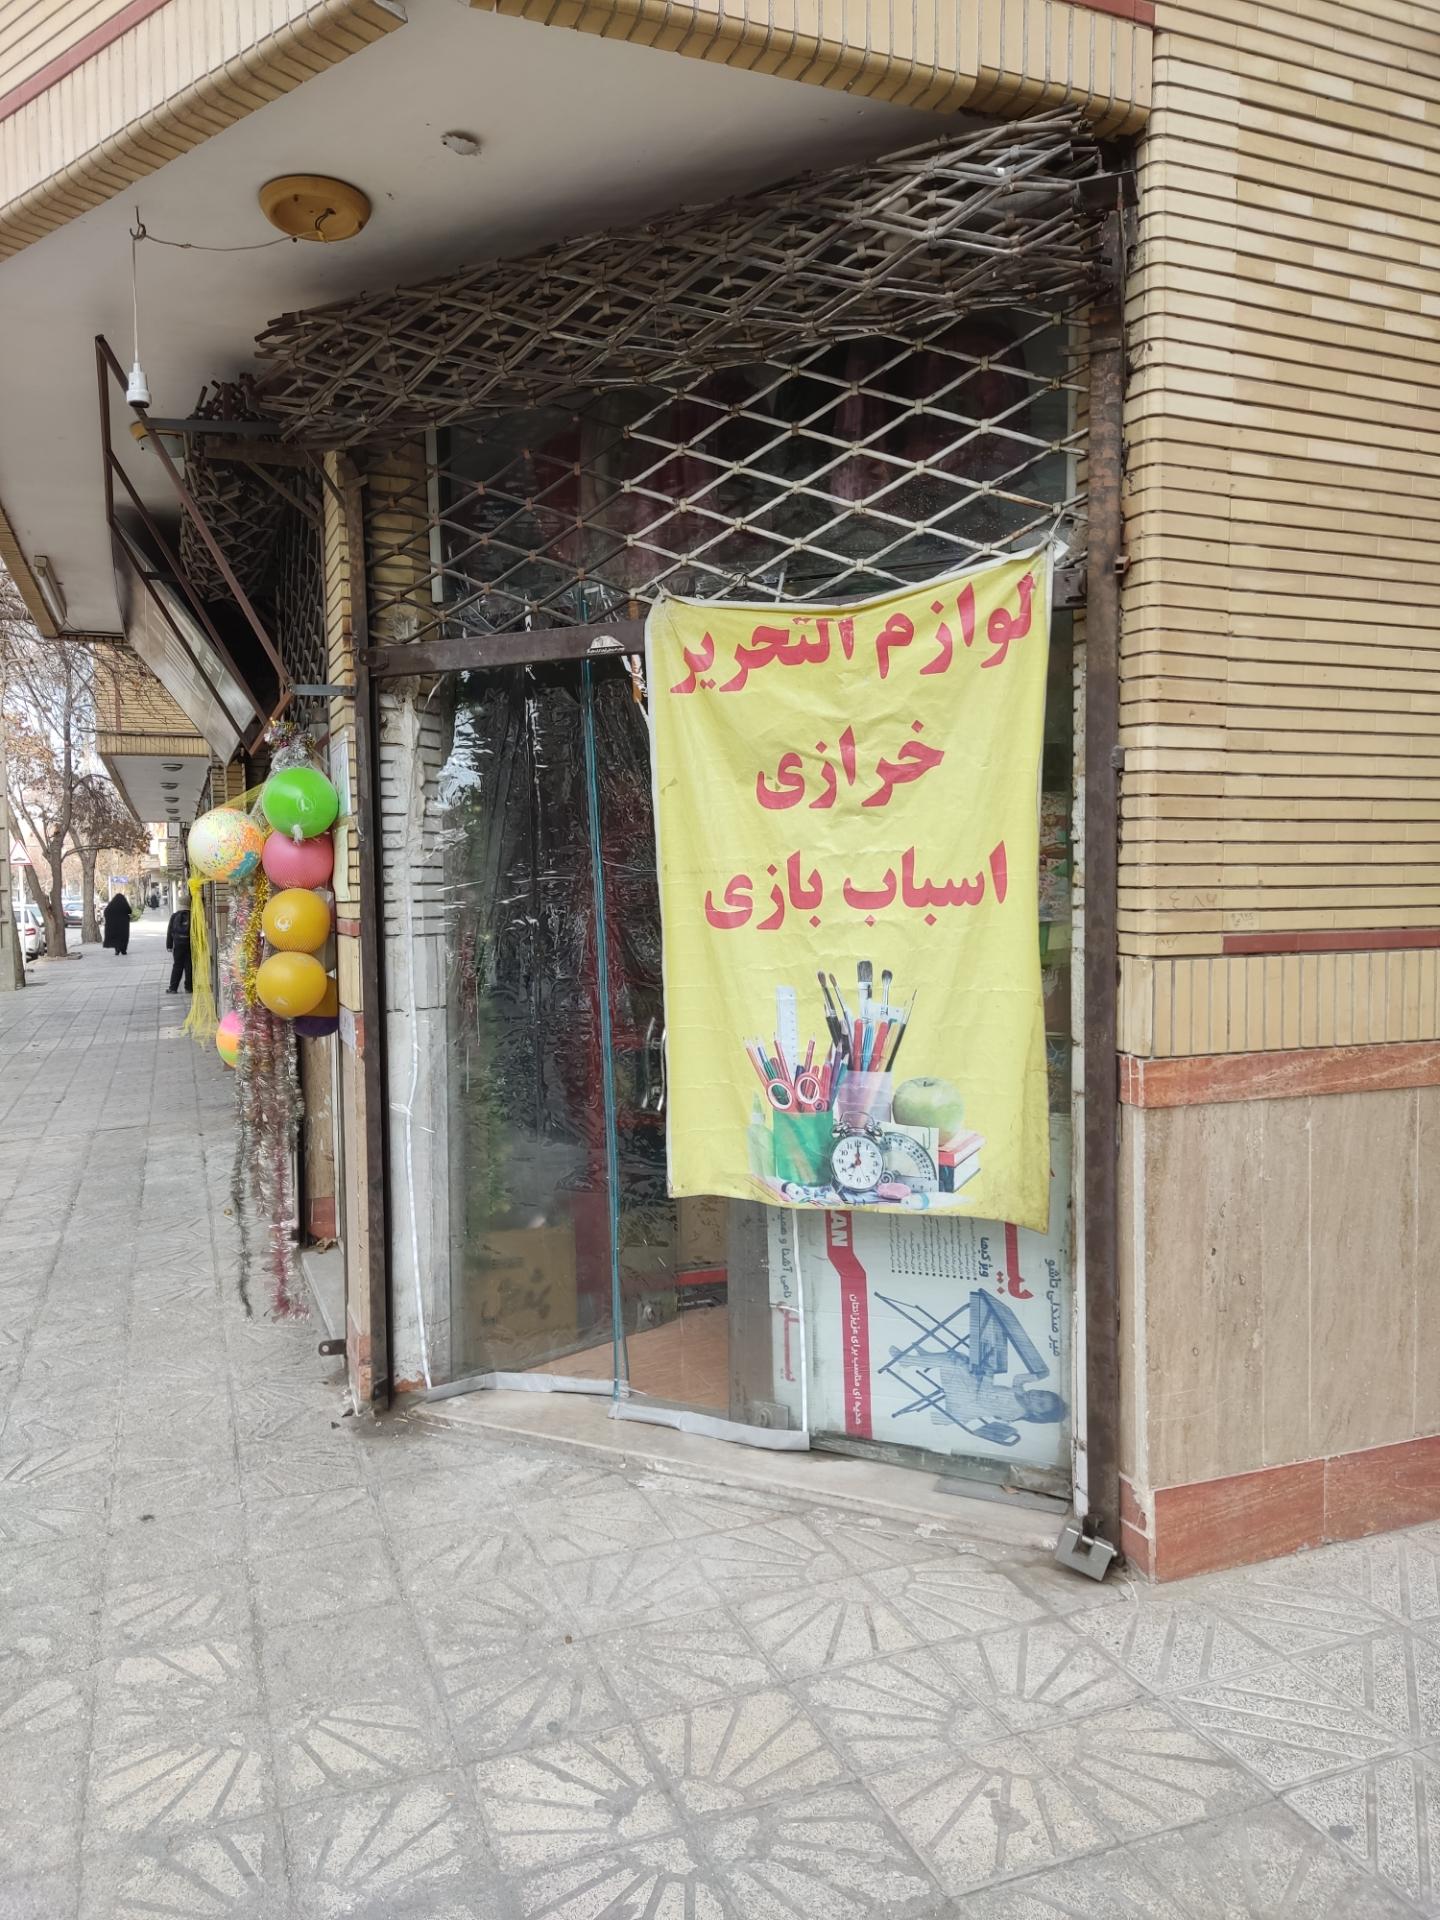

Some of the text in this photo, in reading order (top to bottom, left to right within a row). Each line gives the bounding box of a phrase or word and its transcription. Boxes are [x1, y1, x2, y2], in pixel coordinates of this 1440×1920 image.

[669, 571, 1038, 695] لوازم التحریر
[755, 719, 945, 810] خرازی
[704, 839, 1010, 931] اسباب بازی
[831, 1210, 849, 1247] AN
